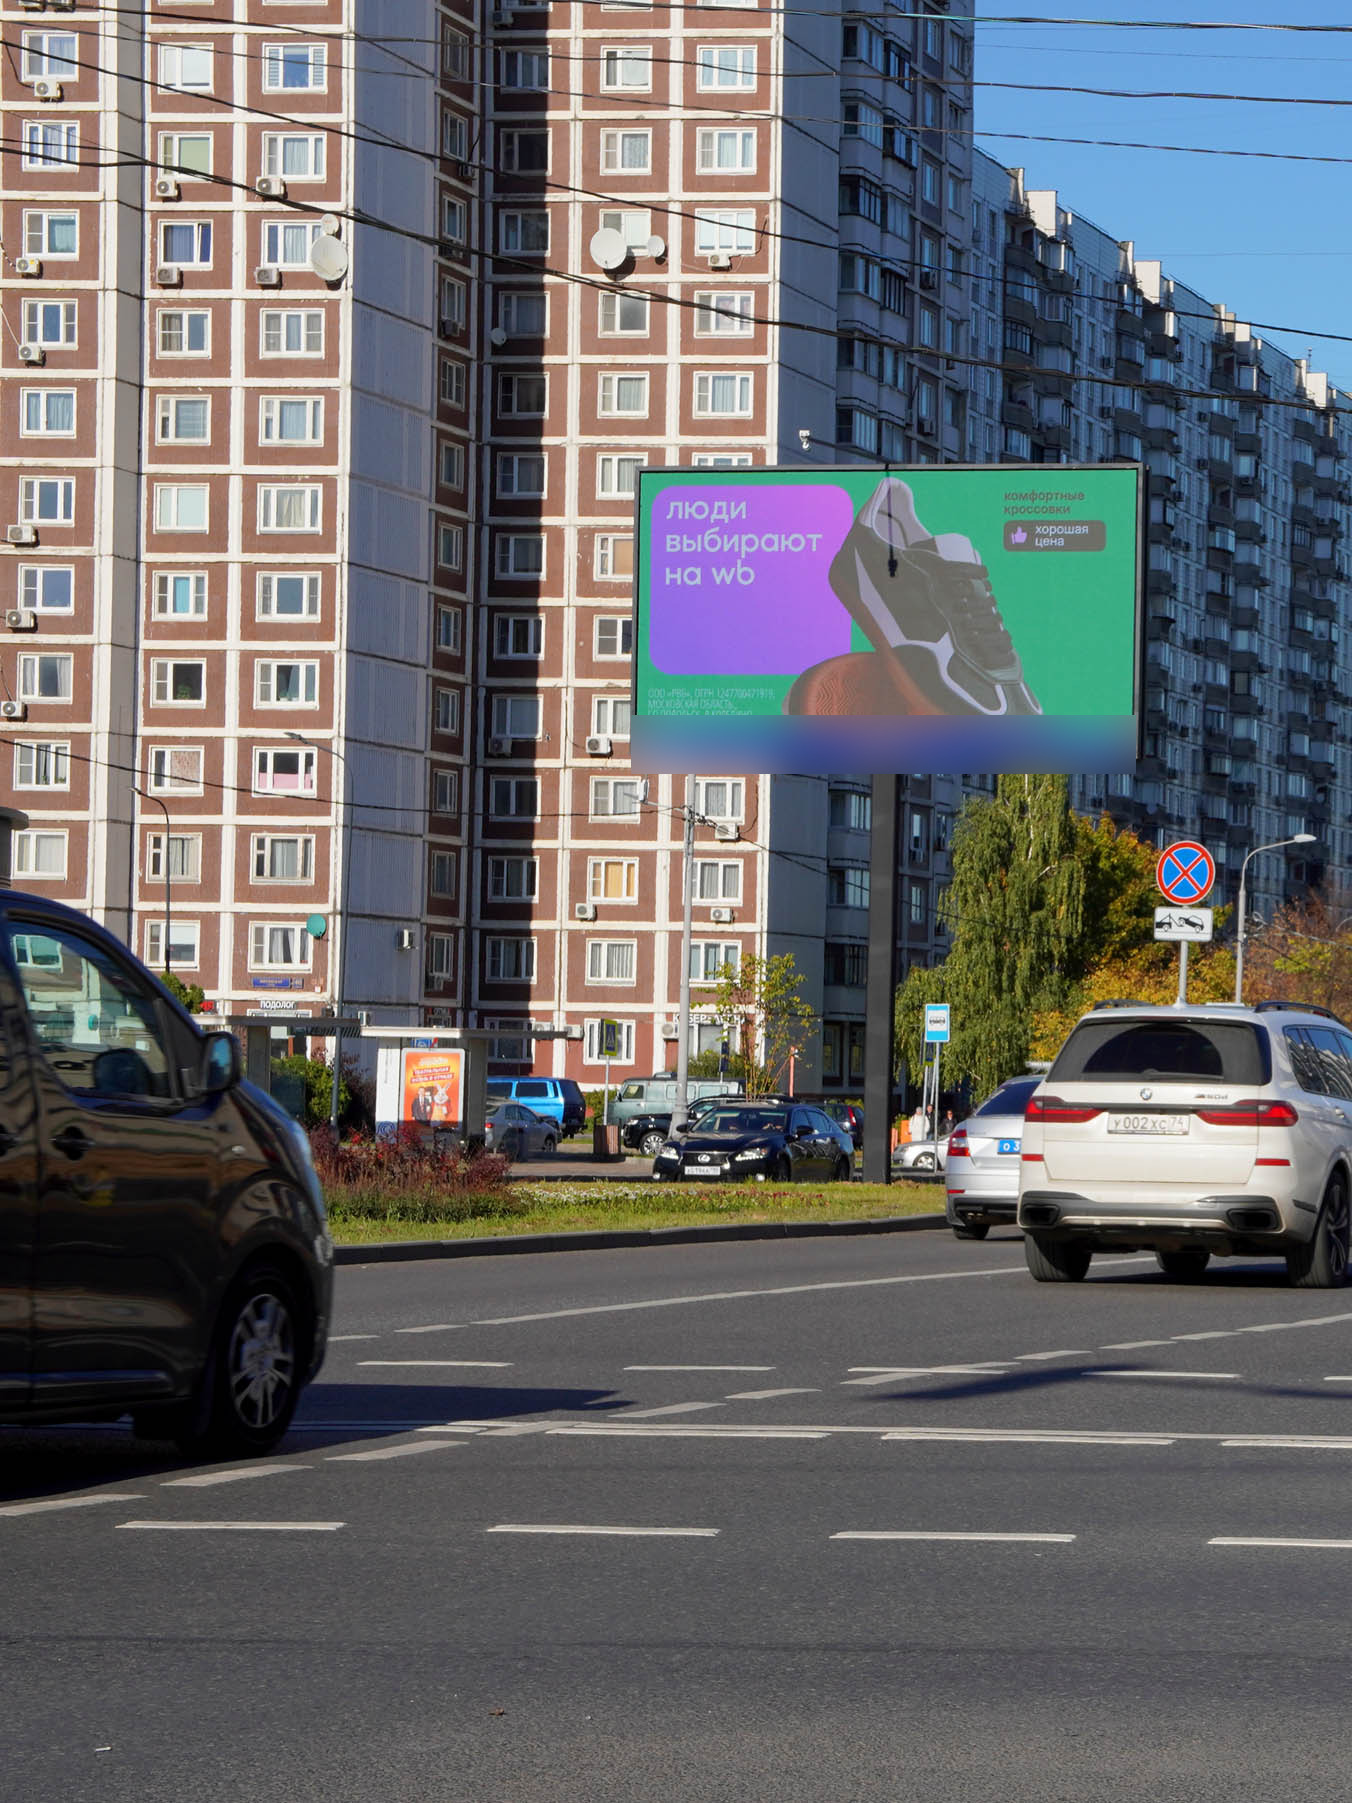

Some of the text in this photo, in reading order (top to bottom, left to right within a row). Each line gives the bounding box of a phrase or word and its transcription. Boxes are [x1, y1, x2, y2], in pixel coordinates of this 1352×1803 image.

[1004, 490, 1085, 503] комфортные
[666, 501, 747, 523] люди
[1004, 505, 1071, 516] кроссовки
[1035, 526, 1089, 536] хорошая
[665, 526, 823, 559] выбирают
[1035, 538, 1065, 548] цена
[665, 559, 756, 585] на wb
[648, 688, 666, 698] ООО
[260, 1001, 296, 1009] ПОДОЛОГ
[1114, 1116, 1167, 1130] У002ХС
